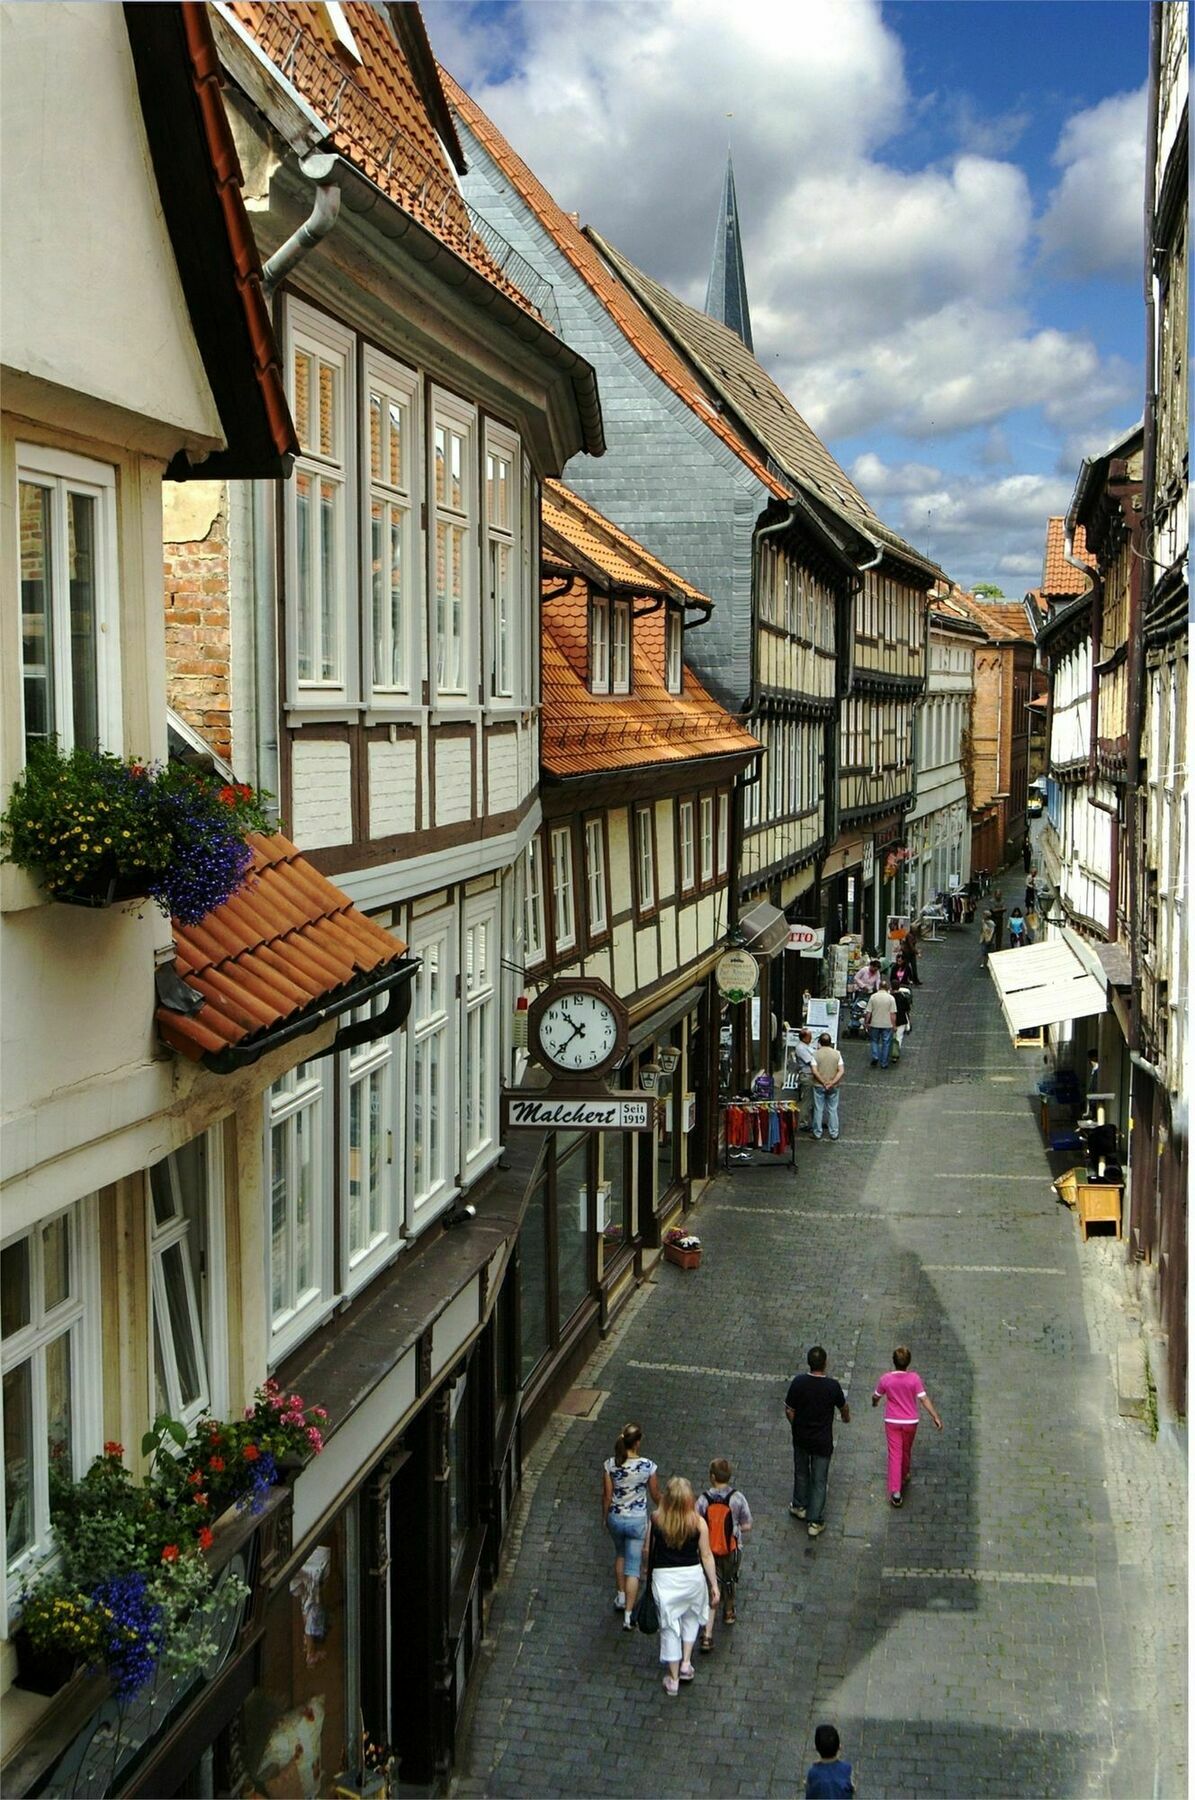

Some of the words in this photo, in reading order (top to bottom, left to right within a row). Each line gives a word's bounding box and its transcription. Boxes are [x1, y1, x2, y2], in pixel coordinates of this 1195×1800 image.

[561, 999, 568, 1010] 11
[573, 994, 583, 1006] 12
[549, 1011, 558, 1020] 10
[600, 1010, 609, 1021] 2
[545, 1025, 552, 1035] 9
[604, 1025, 612, 1036] 3
[549, 1040, 556, 1049] 8
[601, 1040, 607, 1050] 4
[574, 1055, 582, 1064] 6
[590, 1051, 597, 1061] 5
[512, 1102, 616, 1123] Malchert
[623, 1104, 644, 1114] Seit
[623, 1114, 646, 1124] 1919
